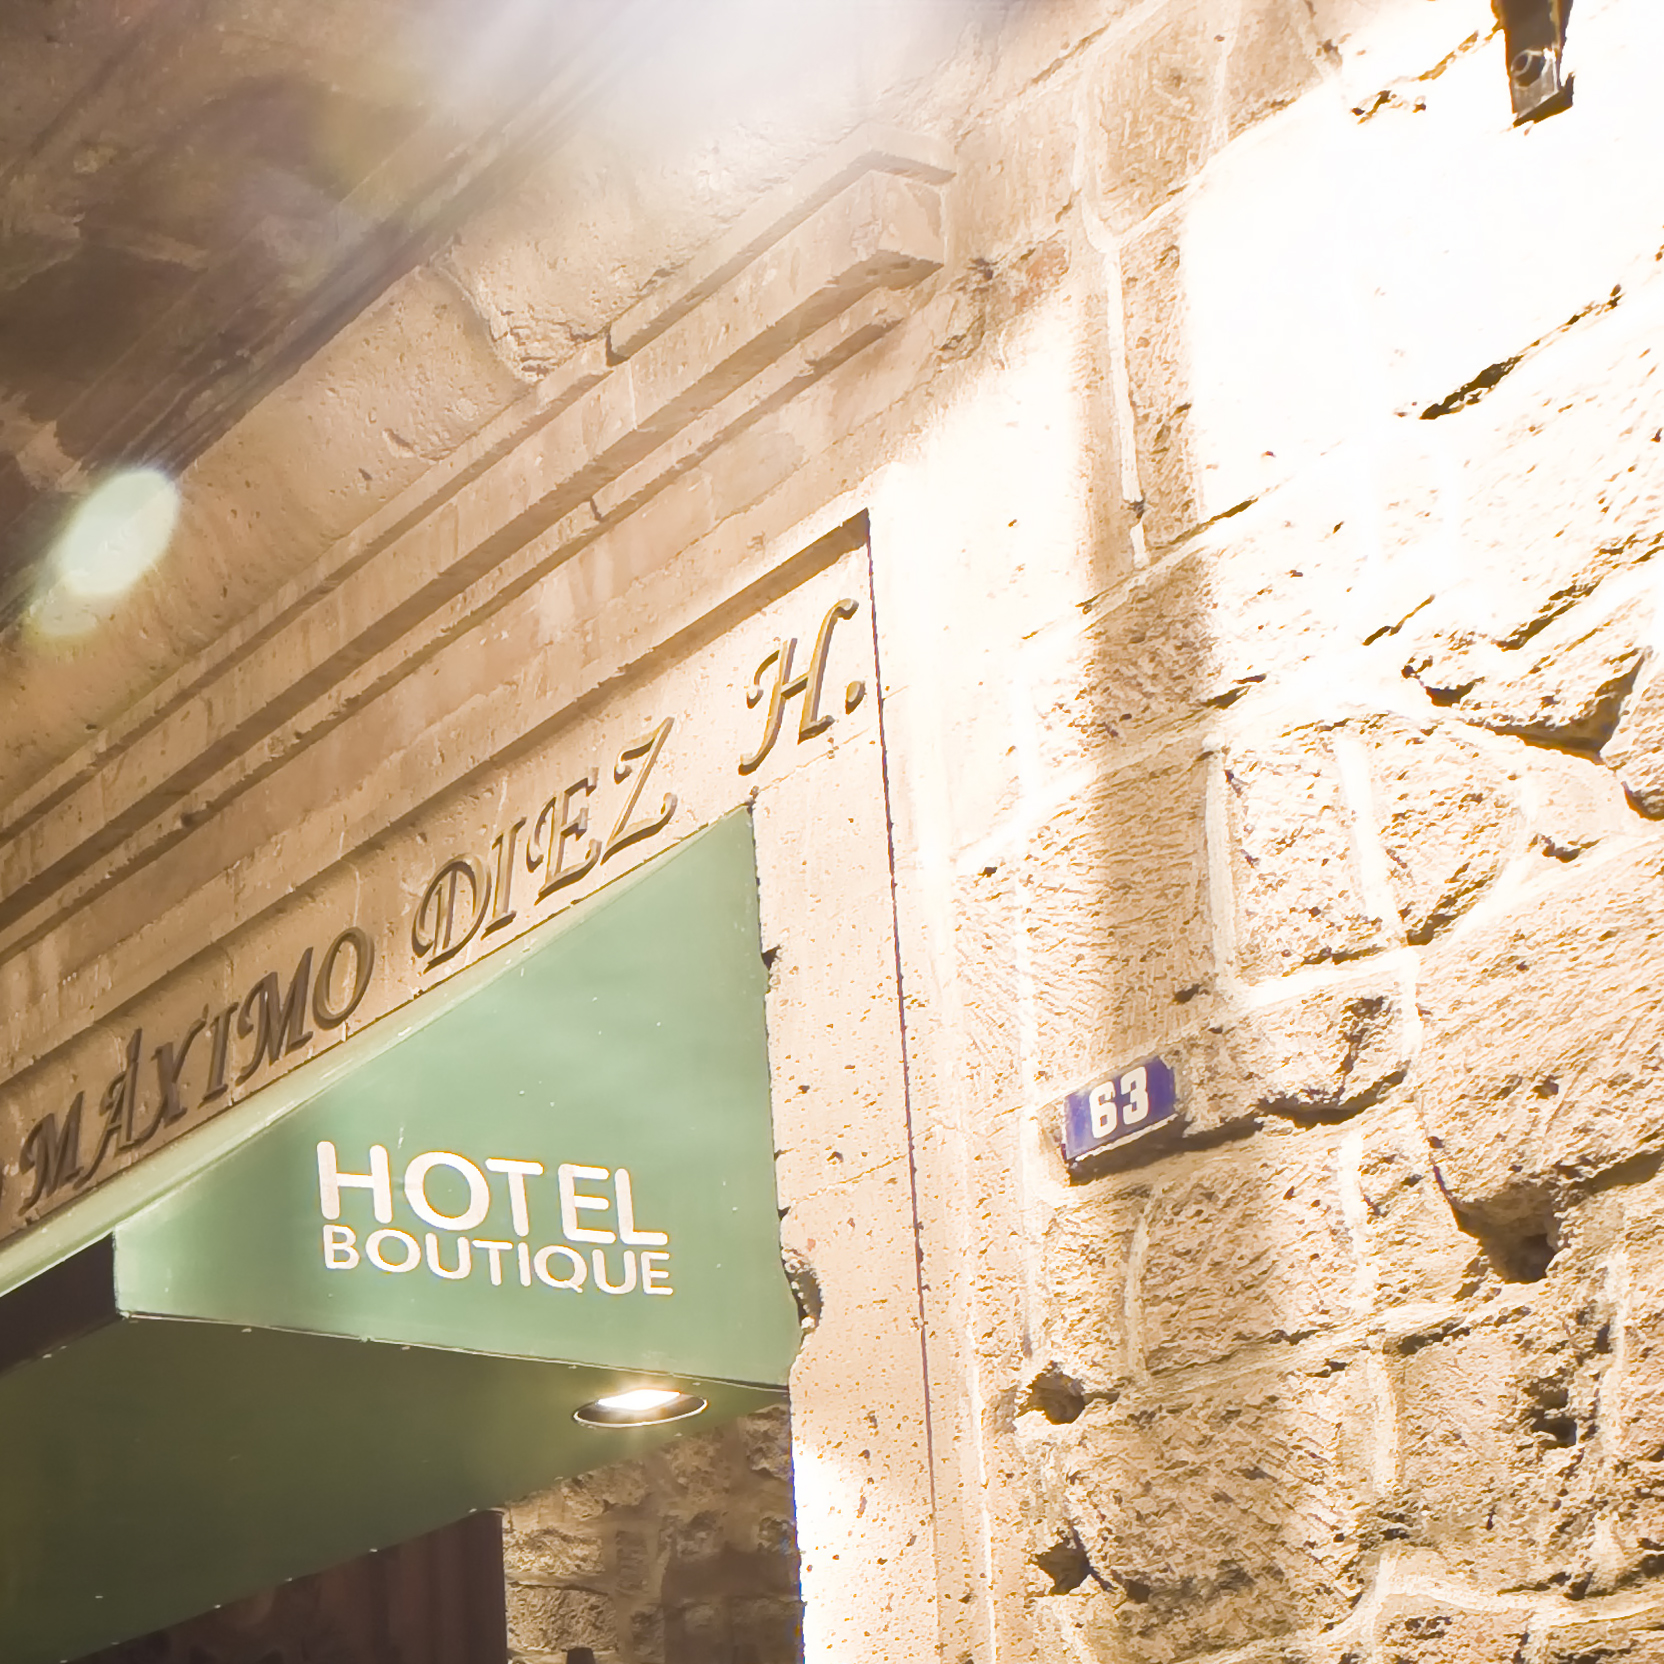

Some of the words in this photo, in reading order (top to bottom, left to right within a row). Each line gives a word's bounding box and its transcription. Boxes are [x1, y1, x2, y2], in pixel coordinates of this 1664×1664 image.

[411, 716, 677, 974] DIEZ
[738, 597, 866, 776] H.
[1089, 1066, 1149, 1139] 63
[316, 1140, 669, 1246] HOTEL
[322, 1223, 673, 1295] BOUTIQUE
